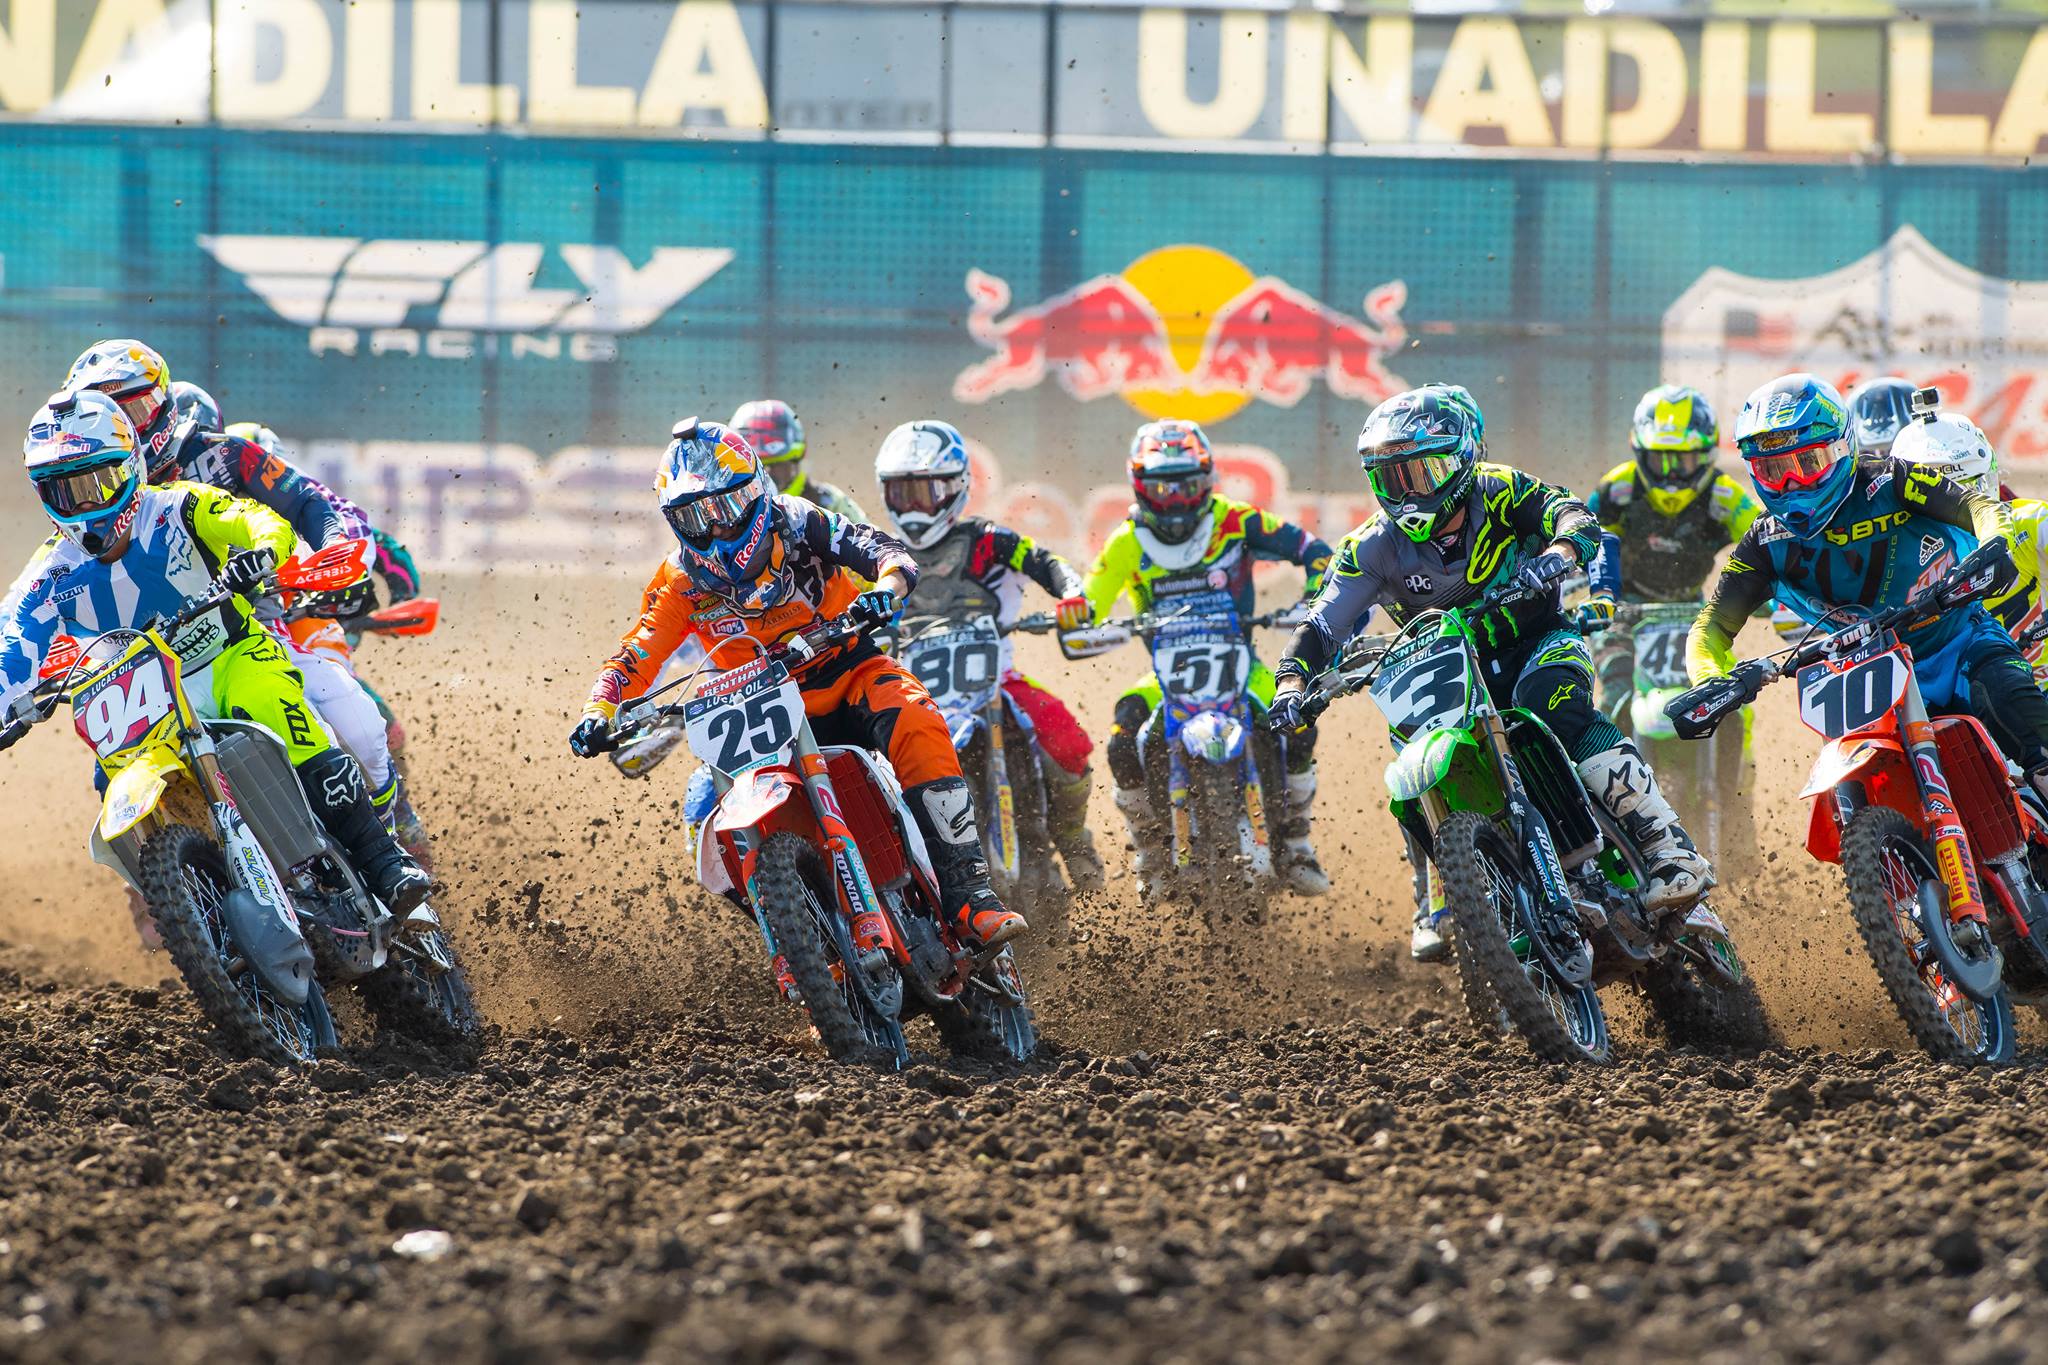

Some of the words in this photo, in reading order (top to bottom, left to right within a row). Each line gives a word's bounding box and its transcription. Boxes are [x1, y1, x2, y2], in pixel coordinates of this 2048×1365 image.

[197, 234, 735, 333] FLY
[308, 328, 618, 362] RACING
[295, 565, 353, 585] ACERBIS
[1405, 576, 1432, 593] PPG
[91, 672, 117, 695] LUCAS
[119, 662, 134, 676] OIL
[911, 643, 999, 698] 80
[1168, 647, 1241, 697] 51
[1390, 656, 1416, 679] LUCAS
[1418, 648, 1433, 661] OIL
[1854, 649, 1870, 663] OIL
[86, 657, 173, 760] 94
[745, 679, 763, 696] OIL
[1390, 652, 1465, 739] 3
[1811, 655, 1894, 738] 10
[279, 698, 315, 747] FOX
[708, 688, 793, 774] 25
[848, 847, 874, 897] MOTOREX
[1528, 840, 1547, 885] CARRILLO
[1534, 826, 1569, 898] DUNLOP
[1939, 847, 1965, 903] PIRELLI
